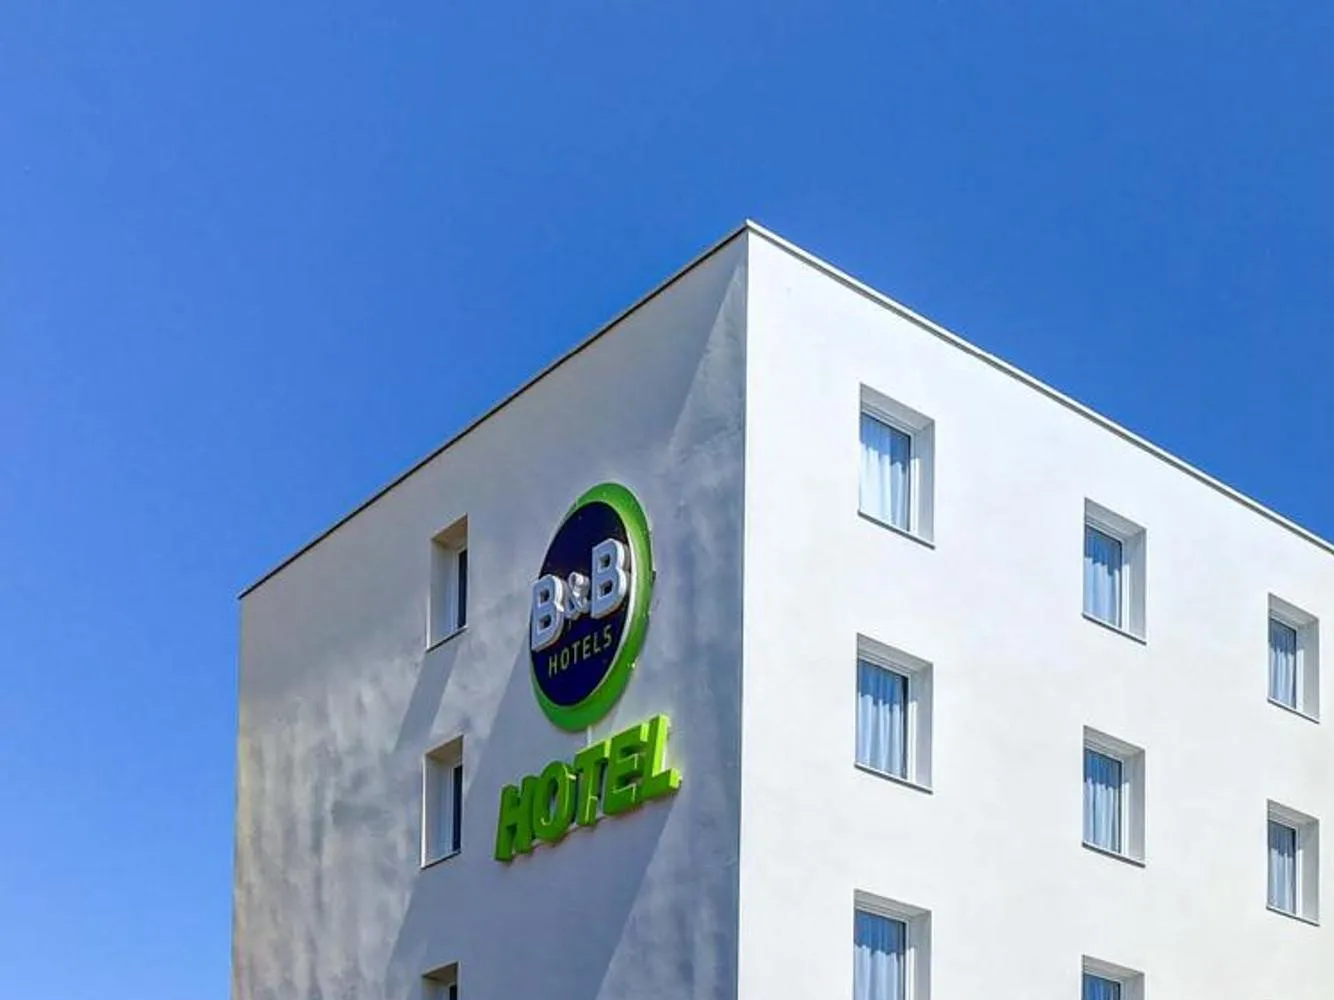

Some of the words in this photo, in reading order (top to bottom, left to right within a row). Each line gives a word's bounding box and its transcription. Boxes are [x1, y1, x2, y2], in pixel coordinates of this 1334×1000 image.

[531, 538, 634, 652] B&B
[548, 624, 613, 678] HOTELS
[494, 712, 682, 862] HOTEL
